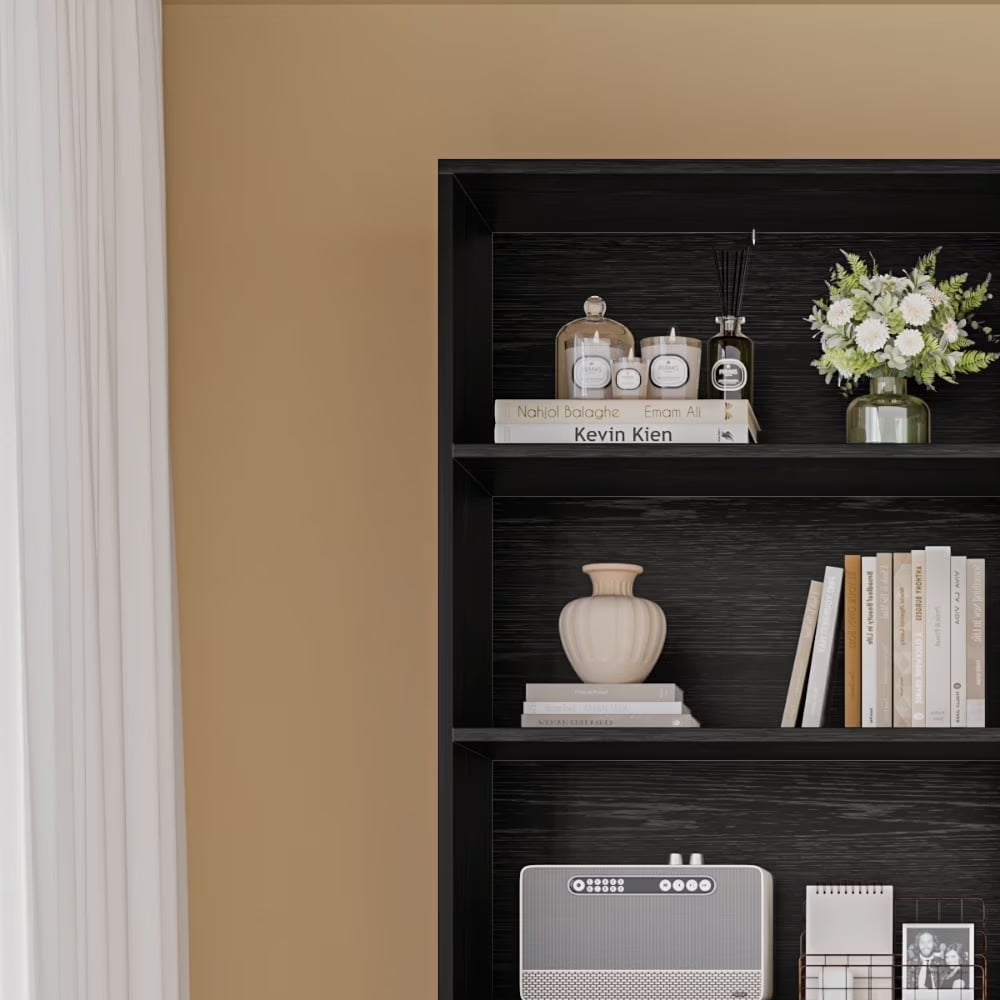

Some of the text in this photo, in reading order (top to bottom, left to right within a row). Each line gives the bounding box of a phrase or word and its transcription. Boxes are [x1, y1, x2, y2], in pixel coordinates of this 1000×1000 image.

[517, 405, 620, 420] Nahjol Balaghe
[644, 405, 702, 418] Emam Ali
[574, 426, 673, 442] Kevin Kien
